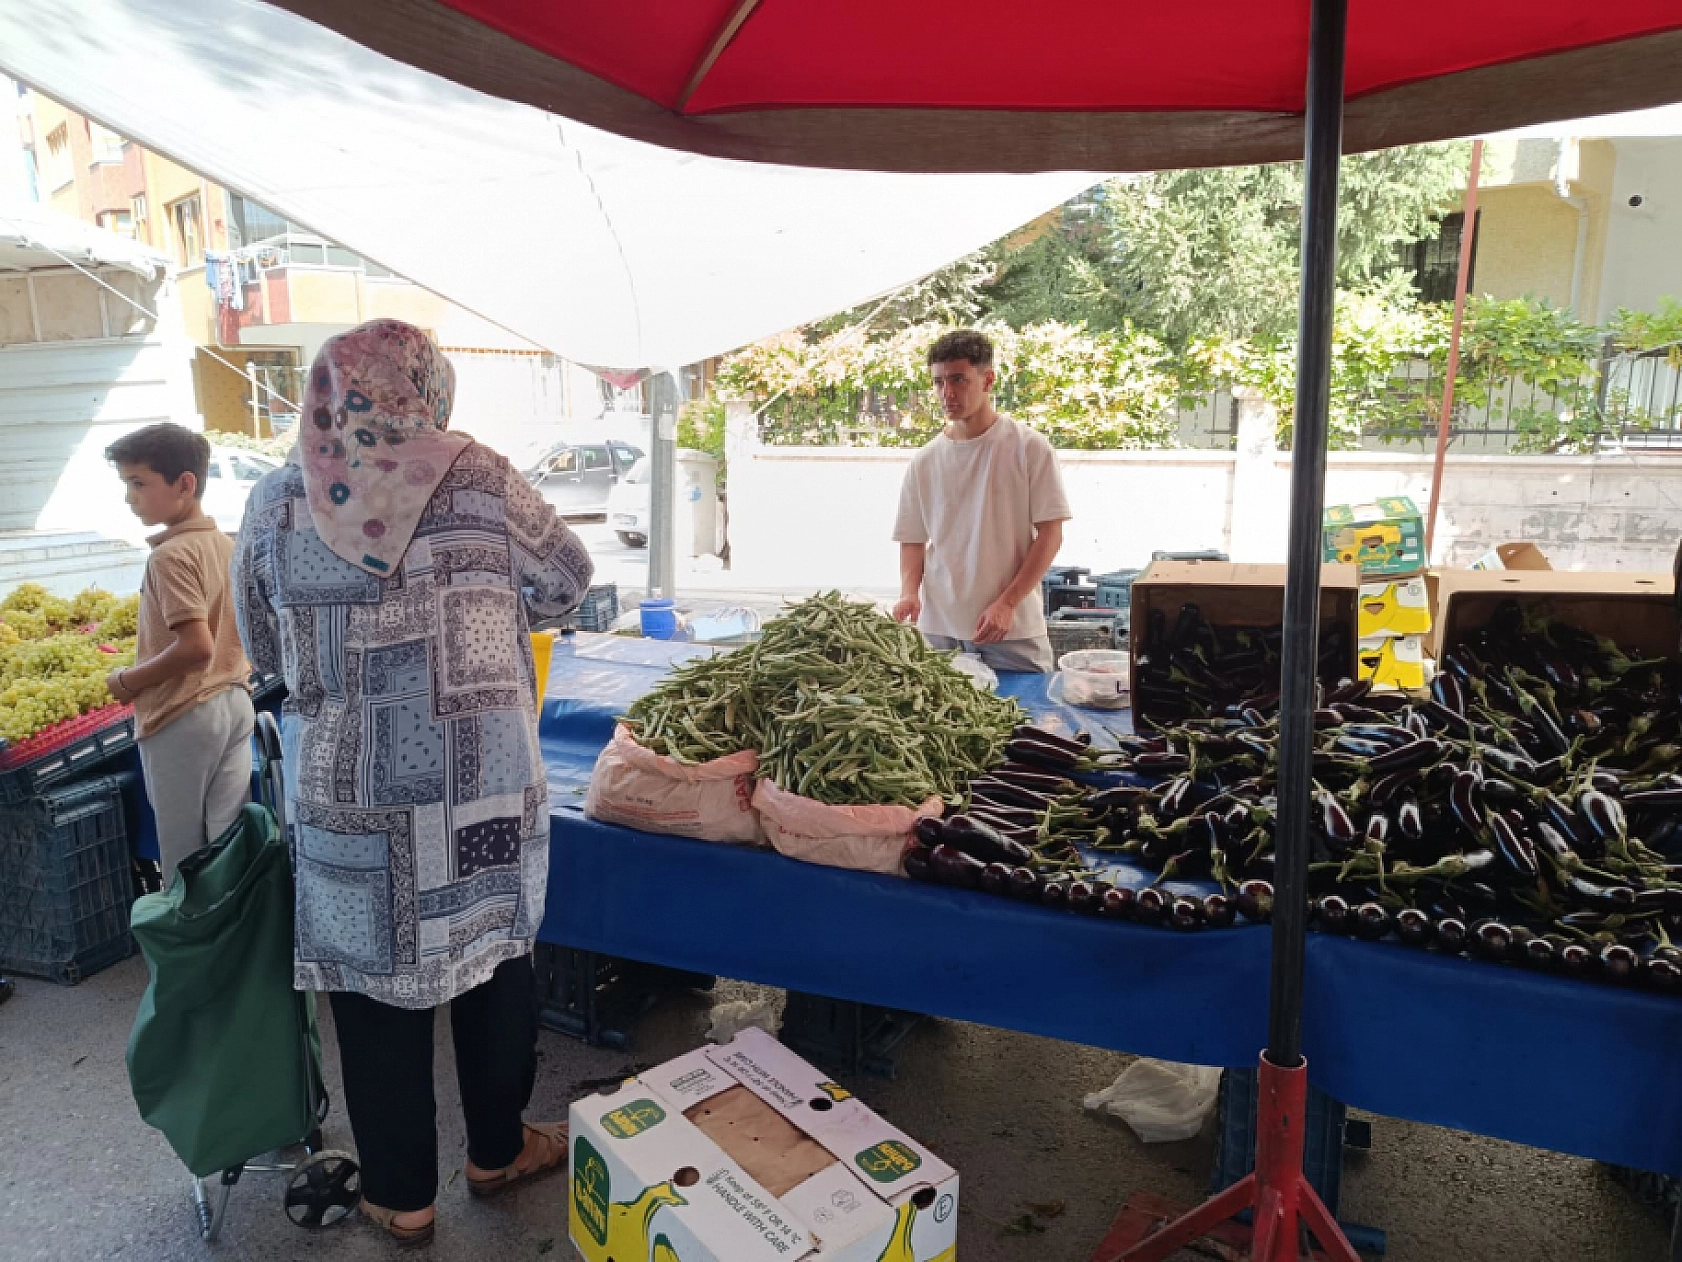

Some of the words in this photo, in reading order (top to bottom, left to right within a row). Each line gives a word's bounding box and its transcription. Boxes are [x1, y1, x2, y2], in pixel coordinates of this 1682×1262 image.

[712, 1183, 747, 1212] HANDLE
[743, 1210, 768, 1233] WITH
[764, 1231, 790, 1254] CARE
